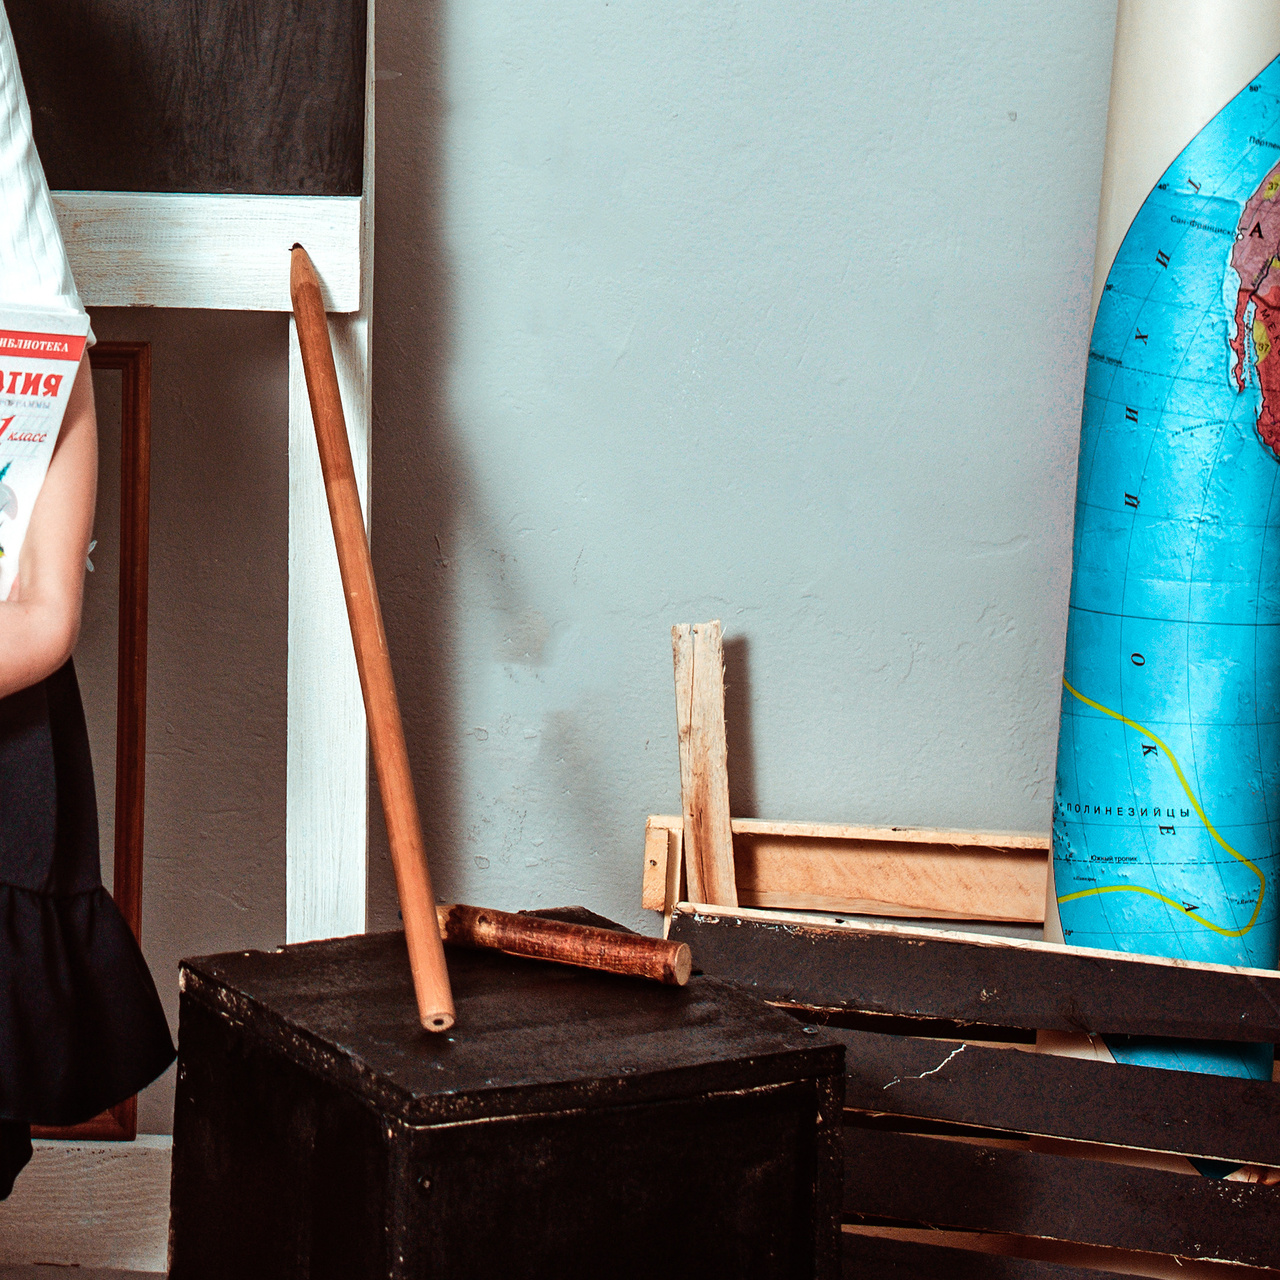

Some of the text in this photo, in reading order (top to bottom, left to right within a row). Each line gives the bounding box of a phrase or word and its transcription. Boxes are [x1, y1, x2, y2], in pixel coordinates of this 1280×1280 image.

[1170, 215, 1237, 236] Сан-Франциско
[7, 431, 47, 443] класс
[1066, 802, 1190, 818] ПОЛИНЕЗИЙЦЫ
[1091, 854, 1113, 862] Южный
